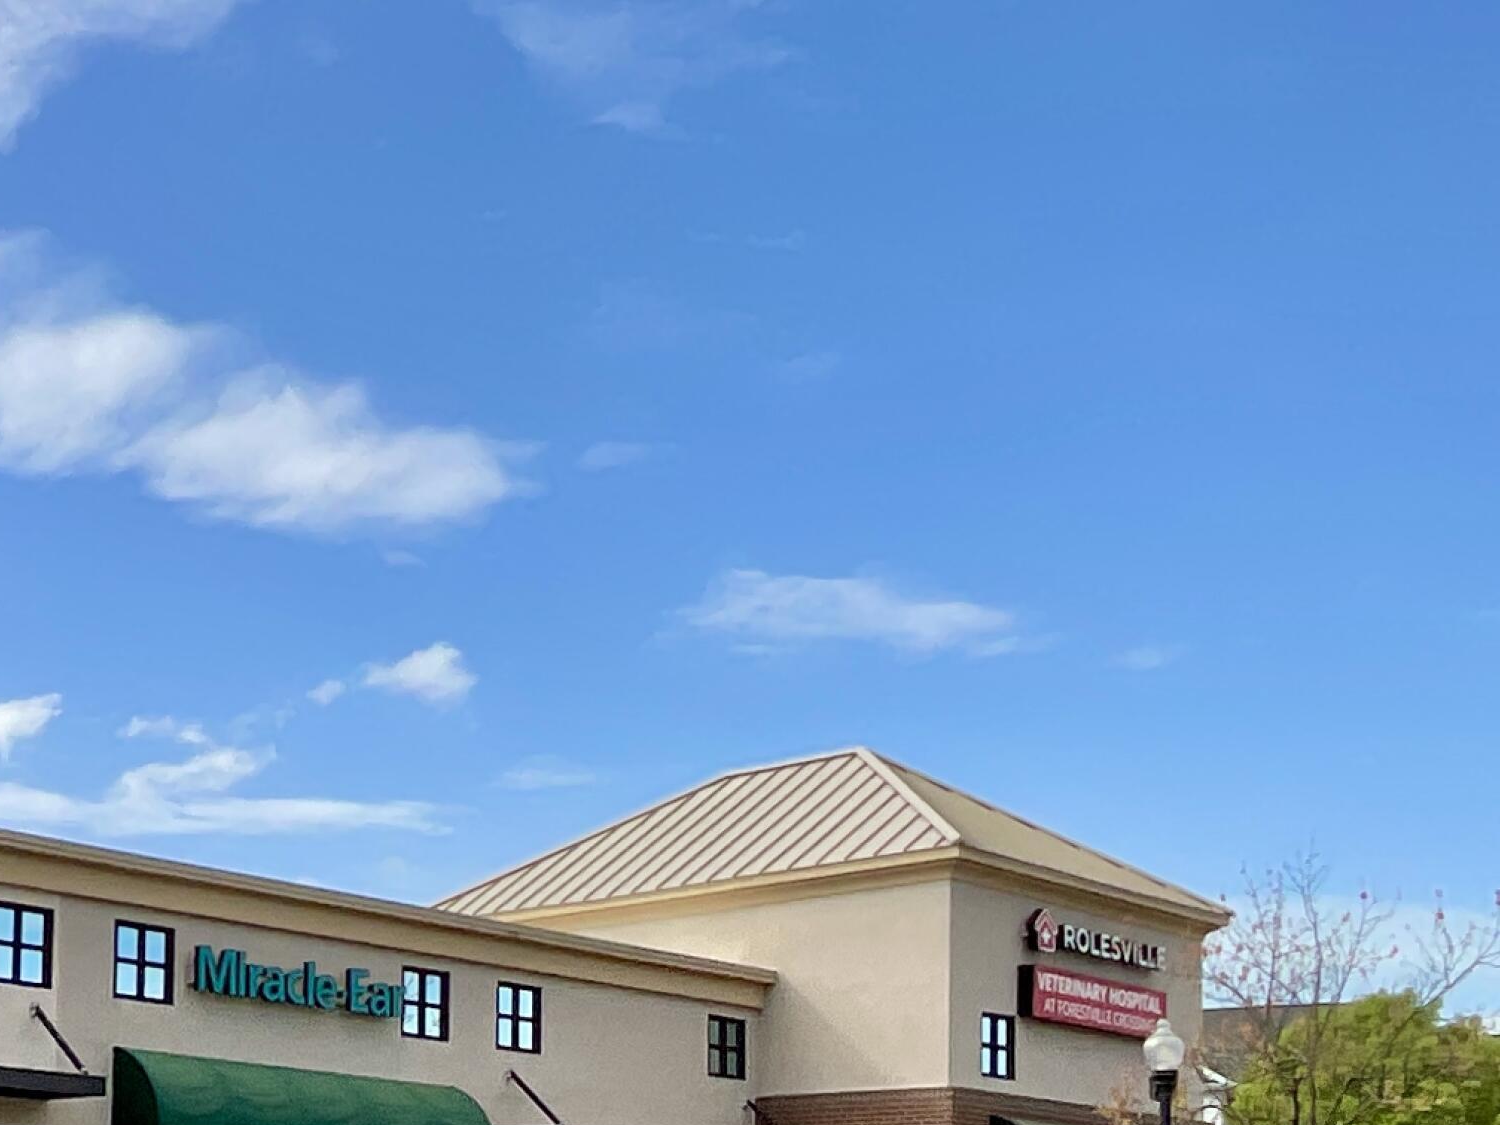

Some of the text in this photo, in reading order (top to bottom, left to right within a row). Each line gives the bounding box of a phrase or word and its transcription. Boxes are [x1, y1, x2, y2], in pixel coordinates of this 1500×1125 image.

[1063, 925, 1166, 970] ROLESVILLE
[194, 943, 407, 1018] Miracle-Ear
[1037, 971, 1162, 1014] VETERINARY HOSPITAL
